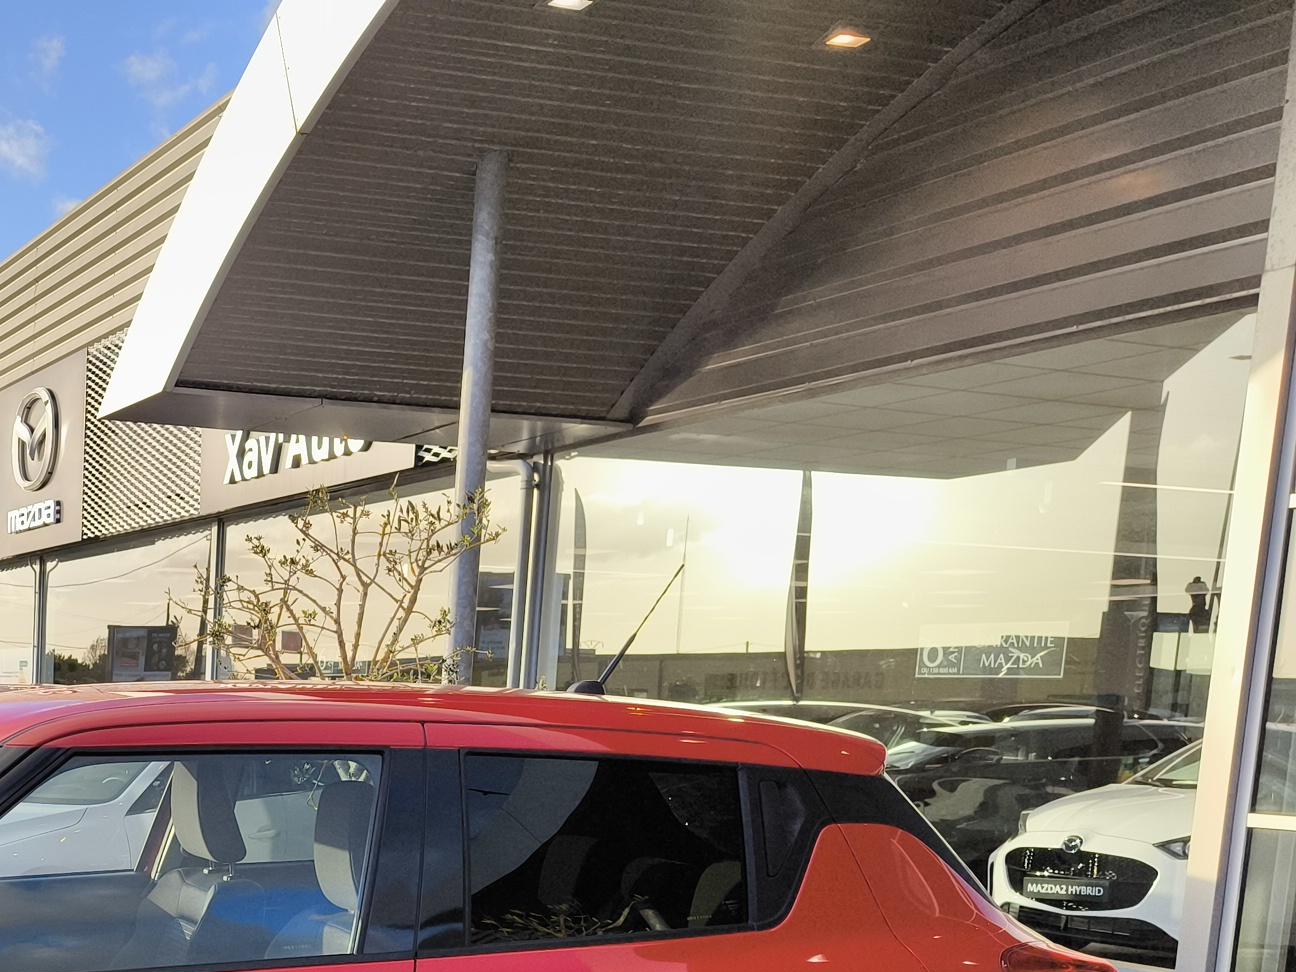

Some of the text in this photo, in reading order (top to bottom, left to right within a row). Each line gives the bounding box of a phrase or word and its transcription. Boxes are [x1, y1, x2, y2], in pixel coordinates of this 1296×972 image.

[7, 499, 58, 534] mazda
[980, 653, 1044, 668] MAZDA
[1027, 883, 1104, 896] MAZDA2 HYBRID
